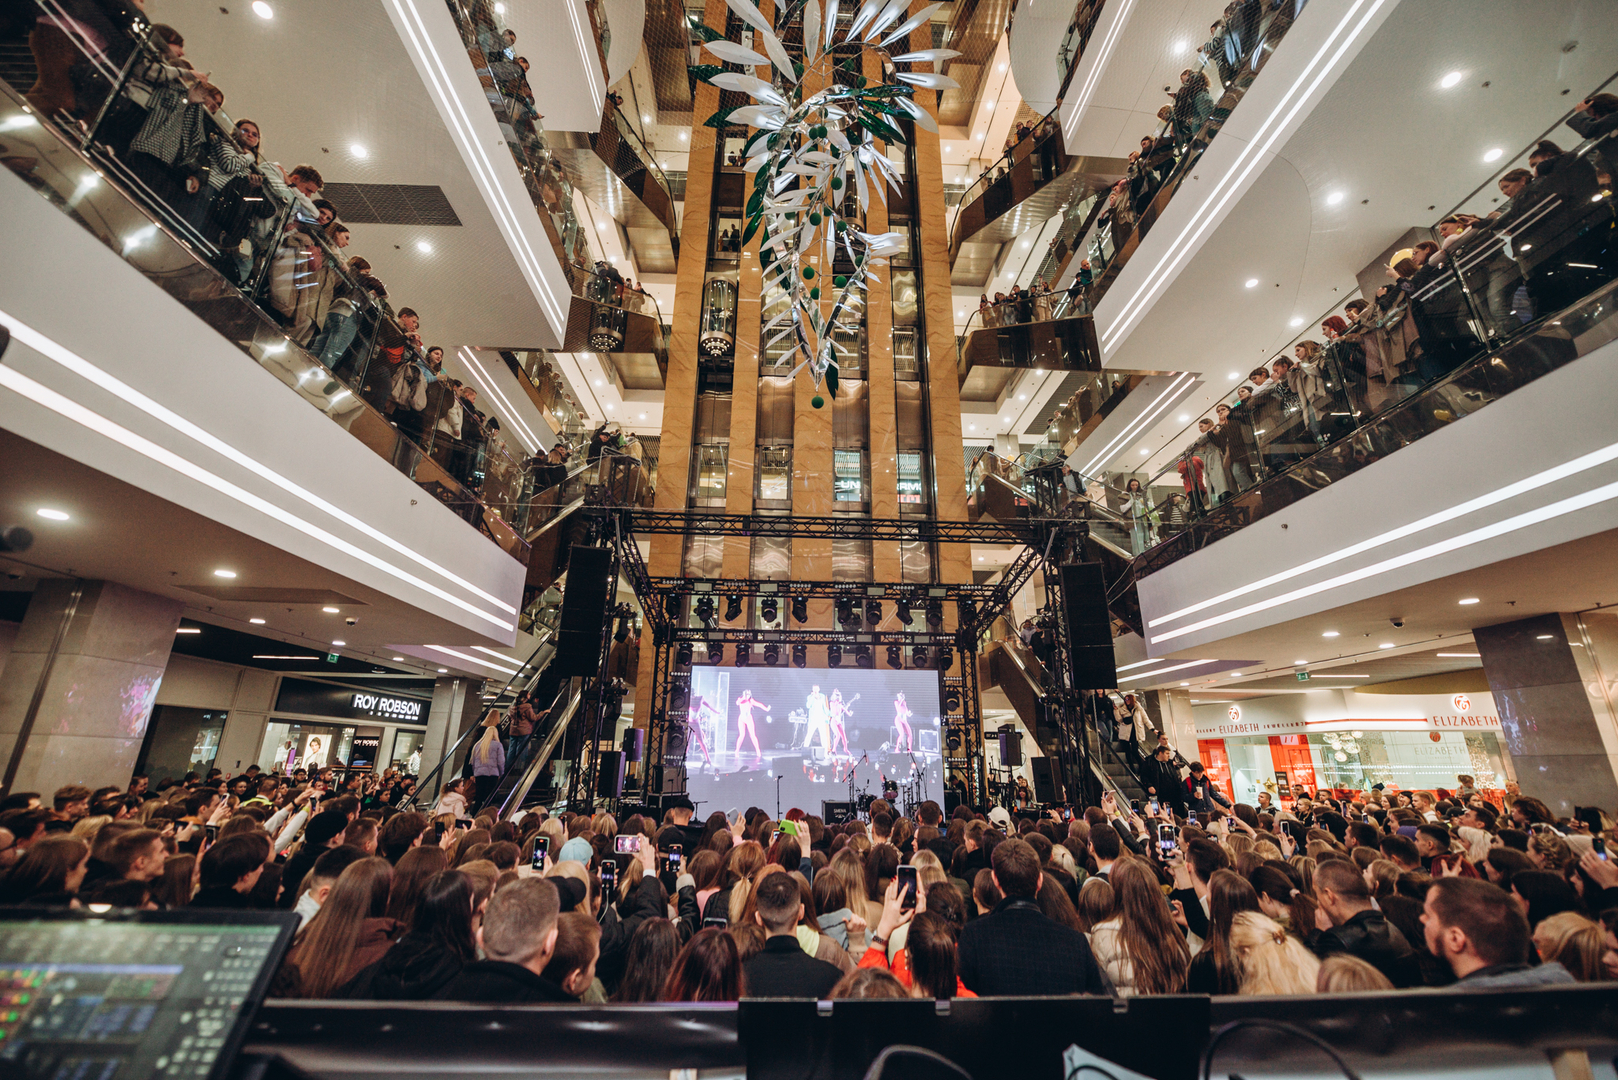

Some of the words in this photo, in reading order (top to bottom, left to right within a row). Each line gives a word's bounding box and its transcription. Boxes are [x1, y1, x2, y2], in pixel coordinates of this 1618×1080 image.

[354, 694, 379, 710] ROY
[378, 698, 421, 716] ROBSON
[1433, 715, 1499, 727] ELIZABETH
[1218, 723, 1260, 734] ELIZABETH
[1414, 746, 1466, 756] ELIZABETH
